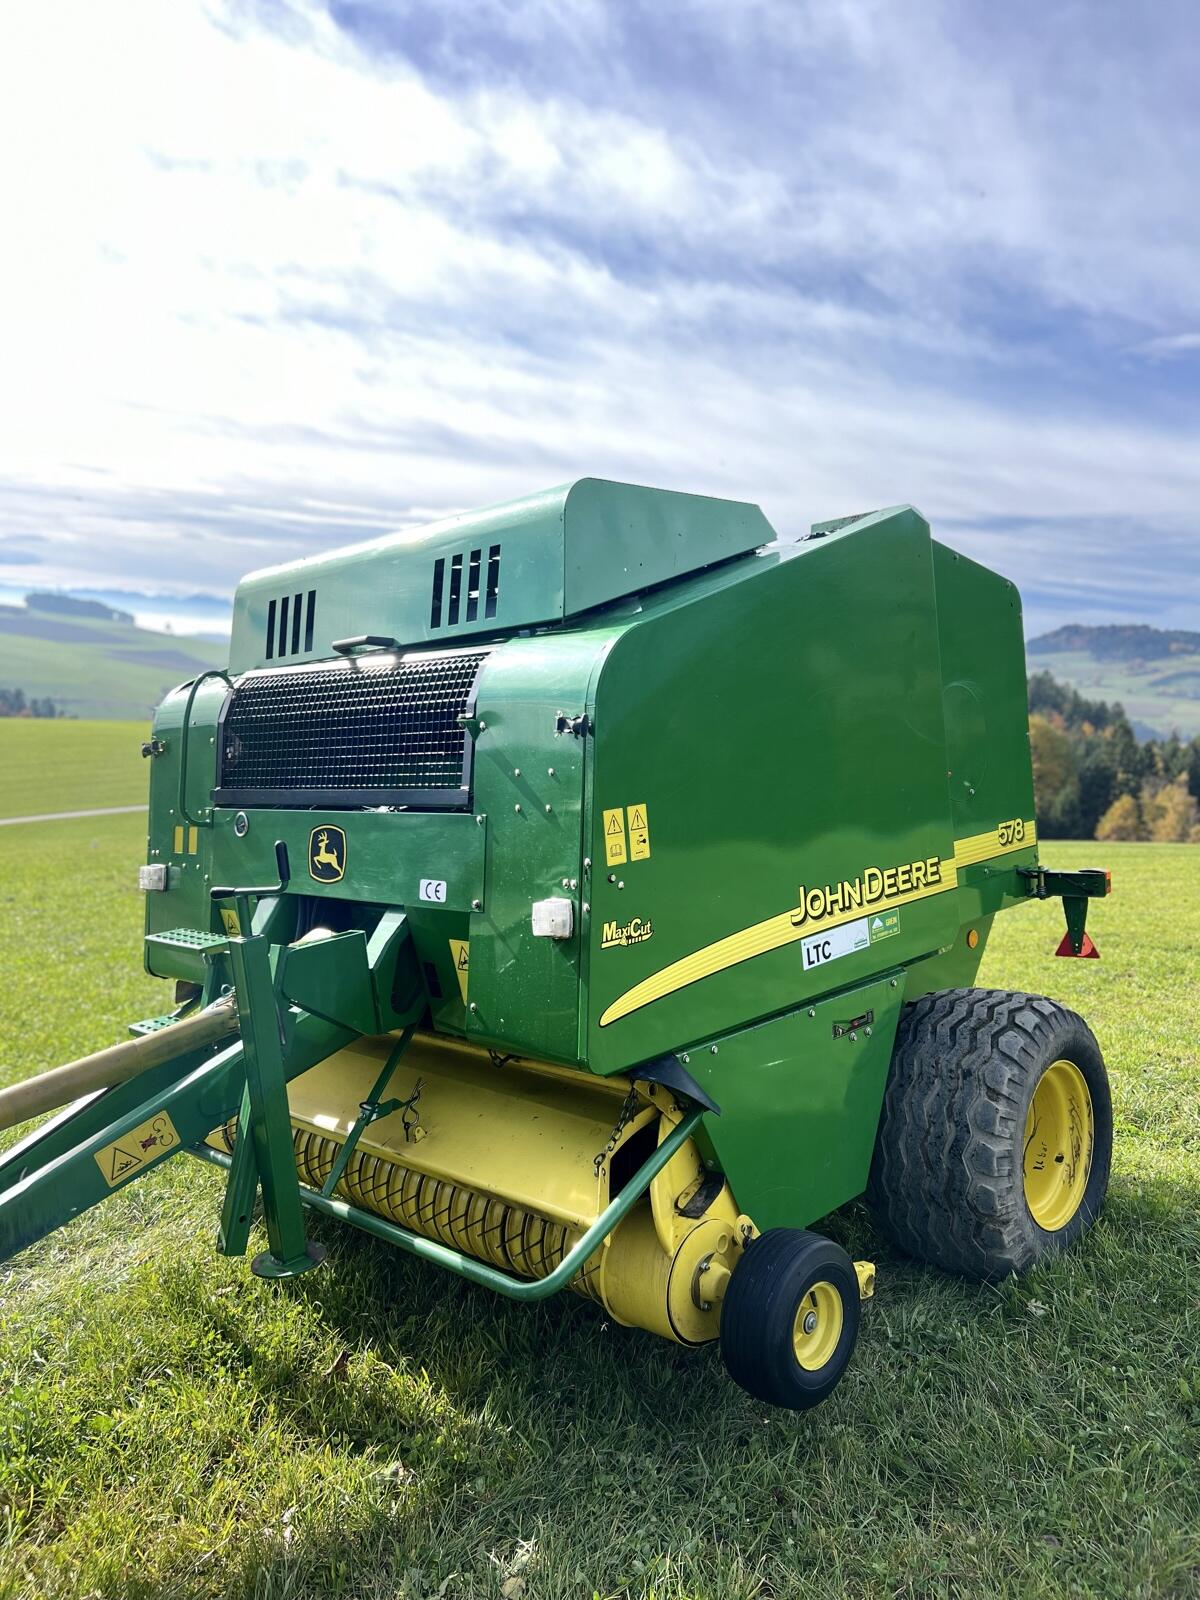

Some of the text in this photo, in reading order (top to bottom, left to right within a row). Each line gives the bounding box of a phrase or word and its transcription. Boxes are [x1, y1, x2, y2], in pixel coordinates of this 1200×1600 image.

[999, 818, 1024, 846] 578
[425, 882, 441, 900] CE
[791, 857, 941, 926] JOHN DEERE
[806, 940, 832, 966] LTC
